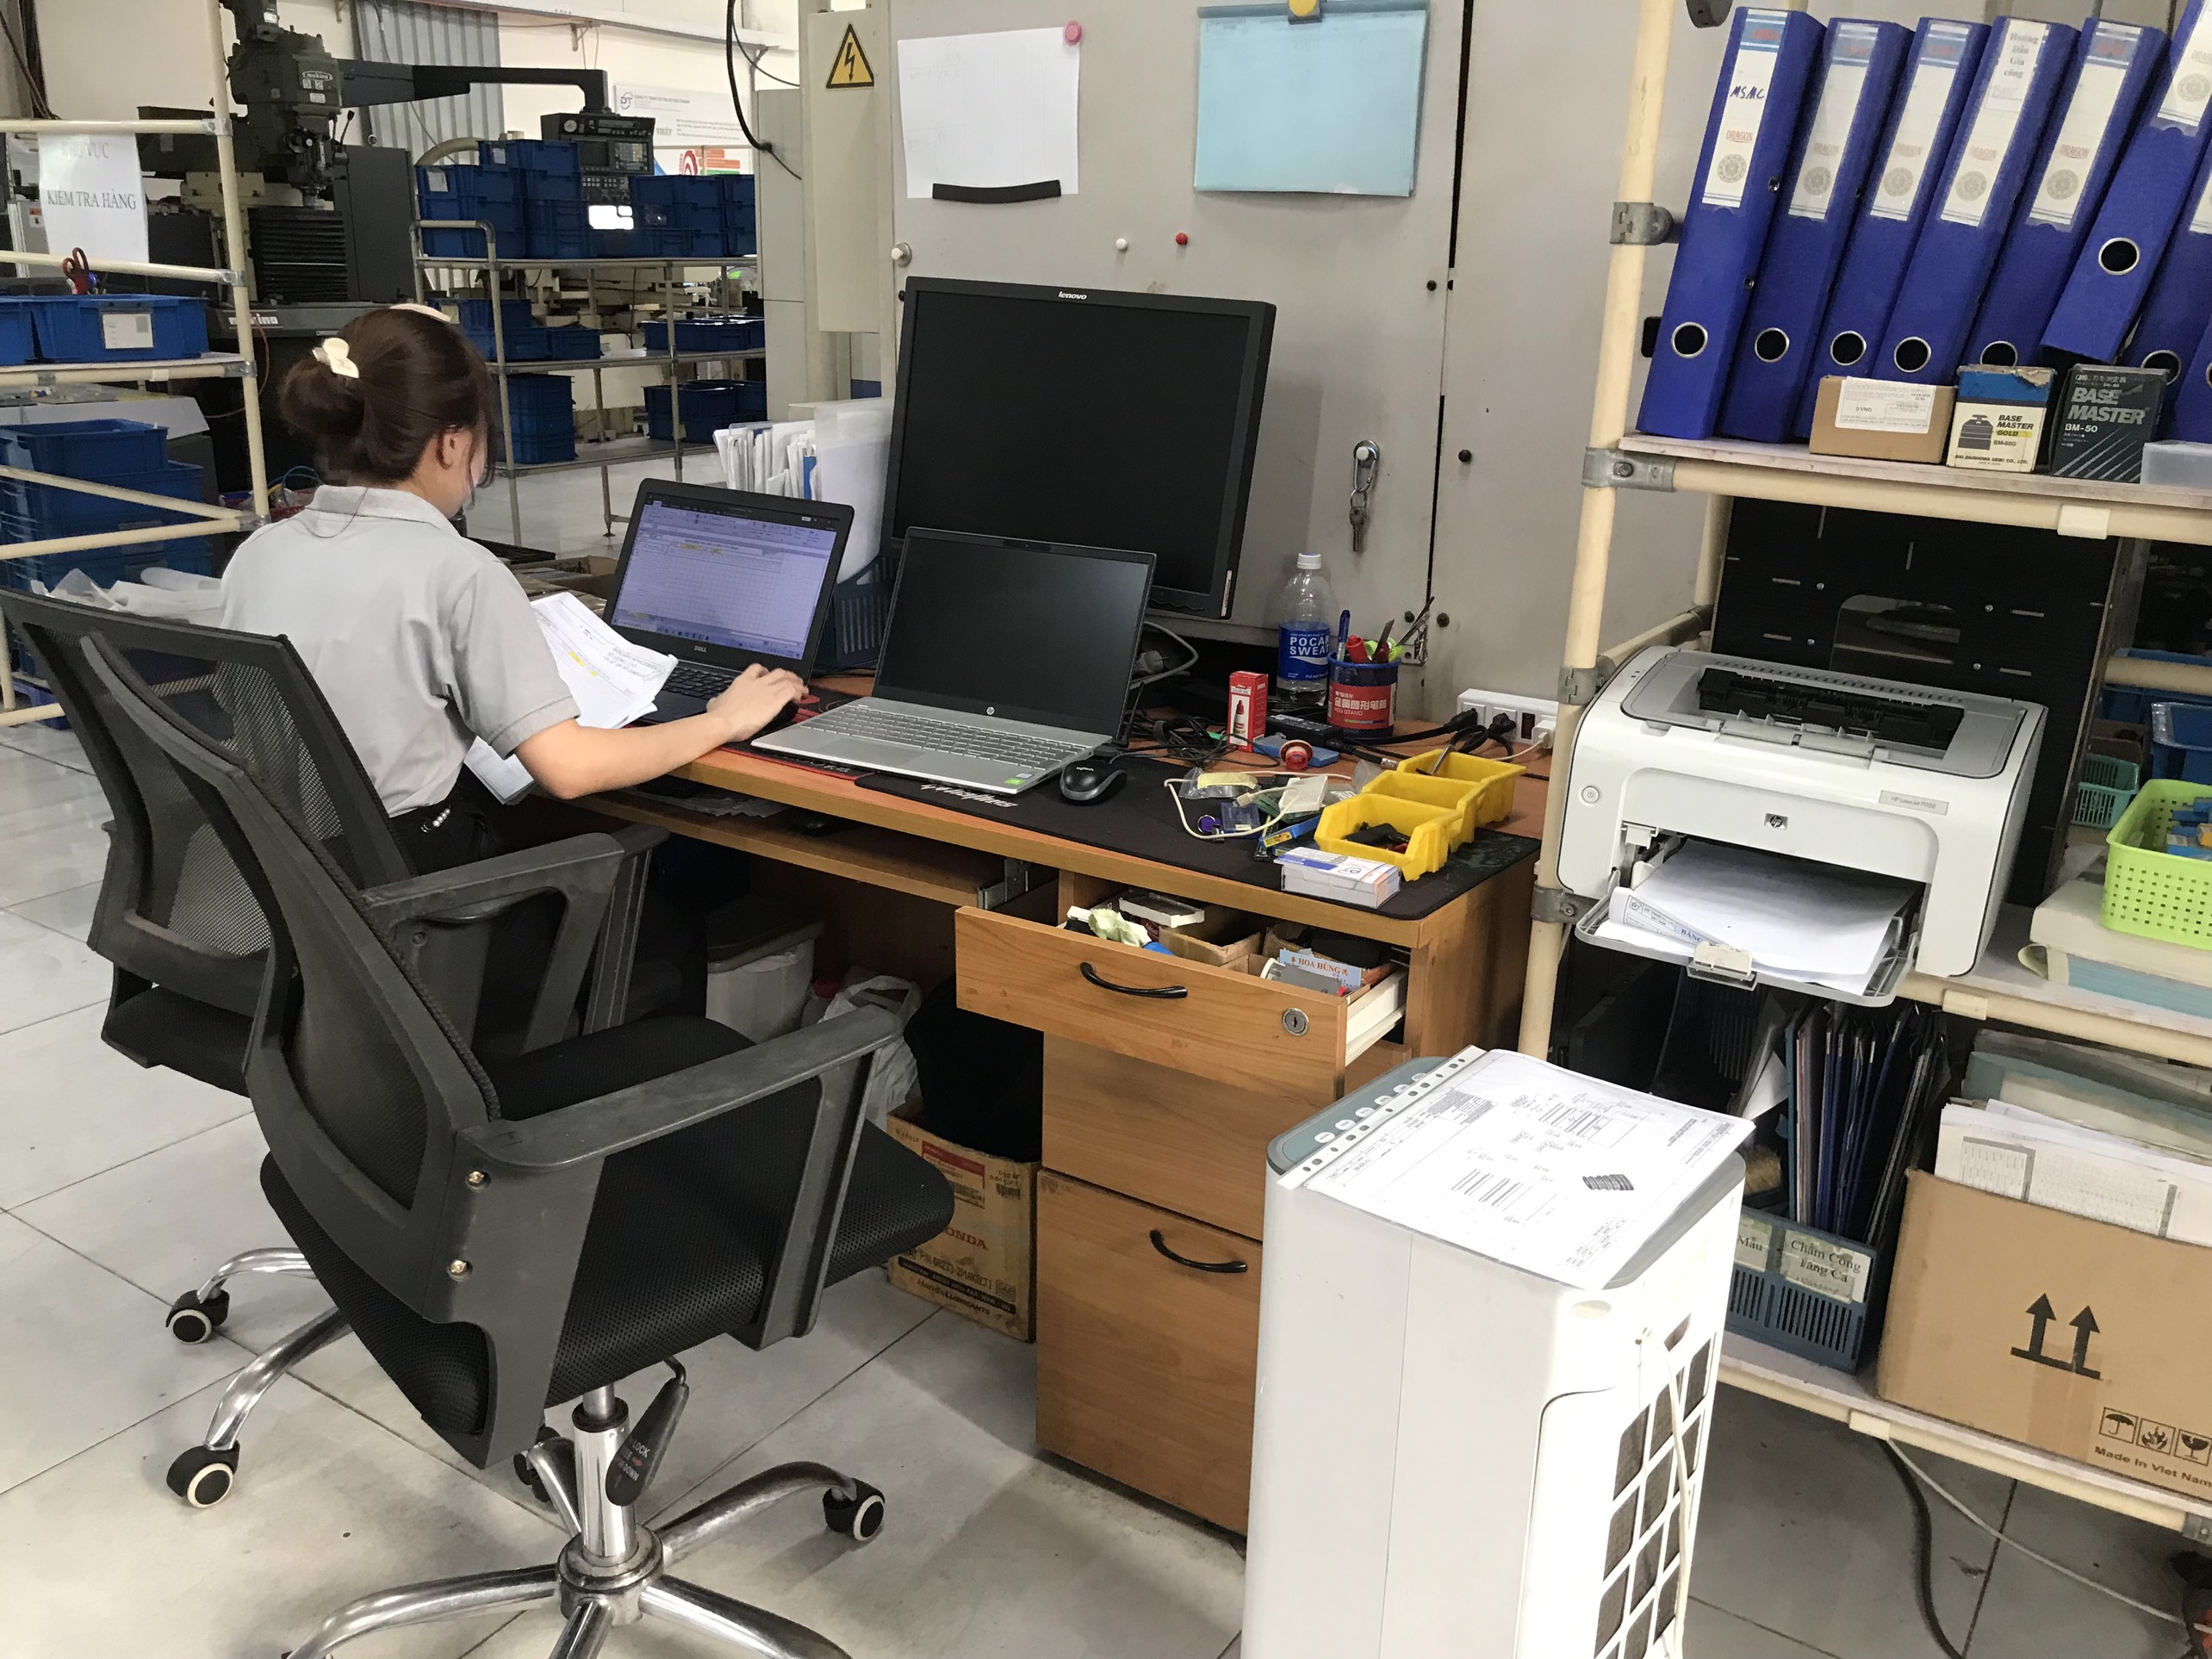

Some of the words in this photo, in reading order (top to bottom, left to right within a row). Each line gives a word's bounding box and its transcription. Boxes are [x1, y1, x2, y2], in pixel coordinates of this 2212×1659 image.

[2010, 56, 2025, 66] Gia
[1730, 85, 1765, 99] MSMC
[1726, 129, 1755, 143] DRAGON
[76, 190, 100, 208] TRA
[102, 188, 136, 210] HÀNG
[1059, 290, 1088, 301] lenovo
[2071, 387, 2122, 405] BASE
[2067, 404, 2146, 425] MASTER
[1997, 421, 2034, 430] MASTER
[2065, 423, 2098, 432] BM-50
[1298, 958, 1315, 968] HOA
[1317, 961, 1340, 974] HÙNG
[944, 1226, 989, 1252] ONDA
[632, 1439, 650, 1458] LOCK
[623, 1463, 640, 1482] DOWN
[2094, 1445, 2131, 1463] Made
[2152, 1463, 2178, 1477] Viet
[2181, 1472, 2212, 1488] Nam
